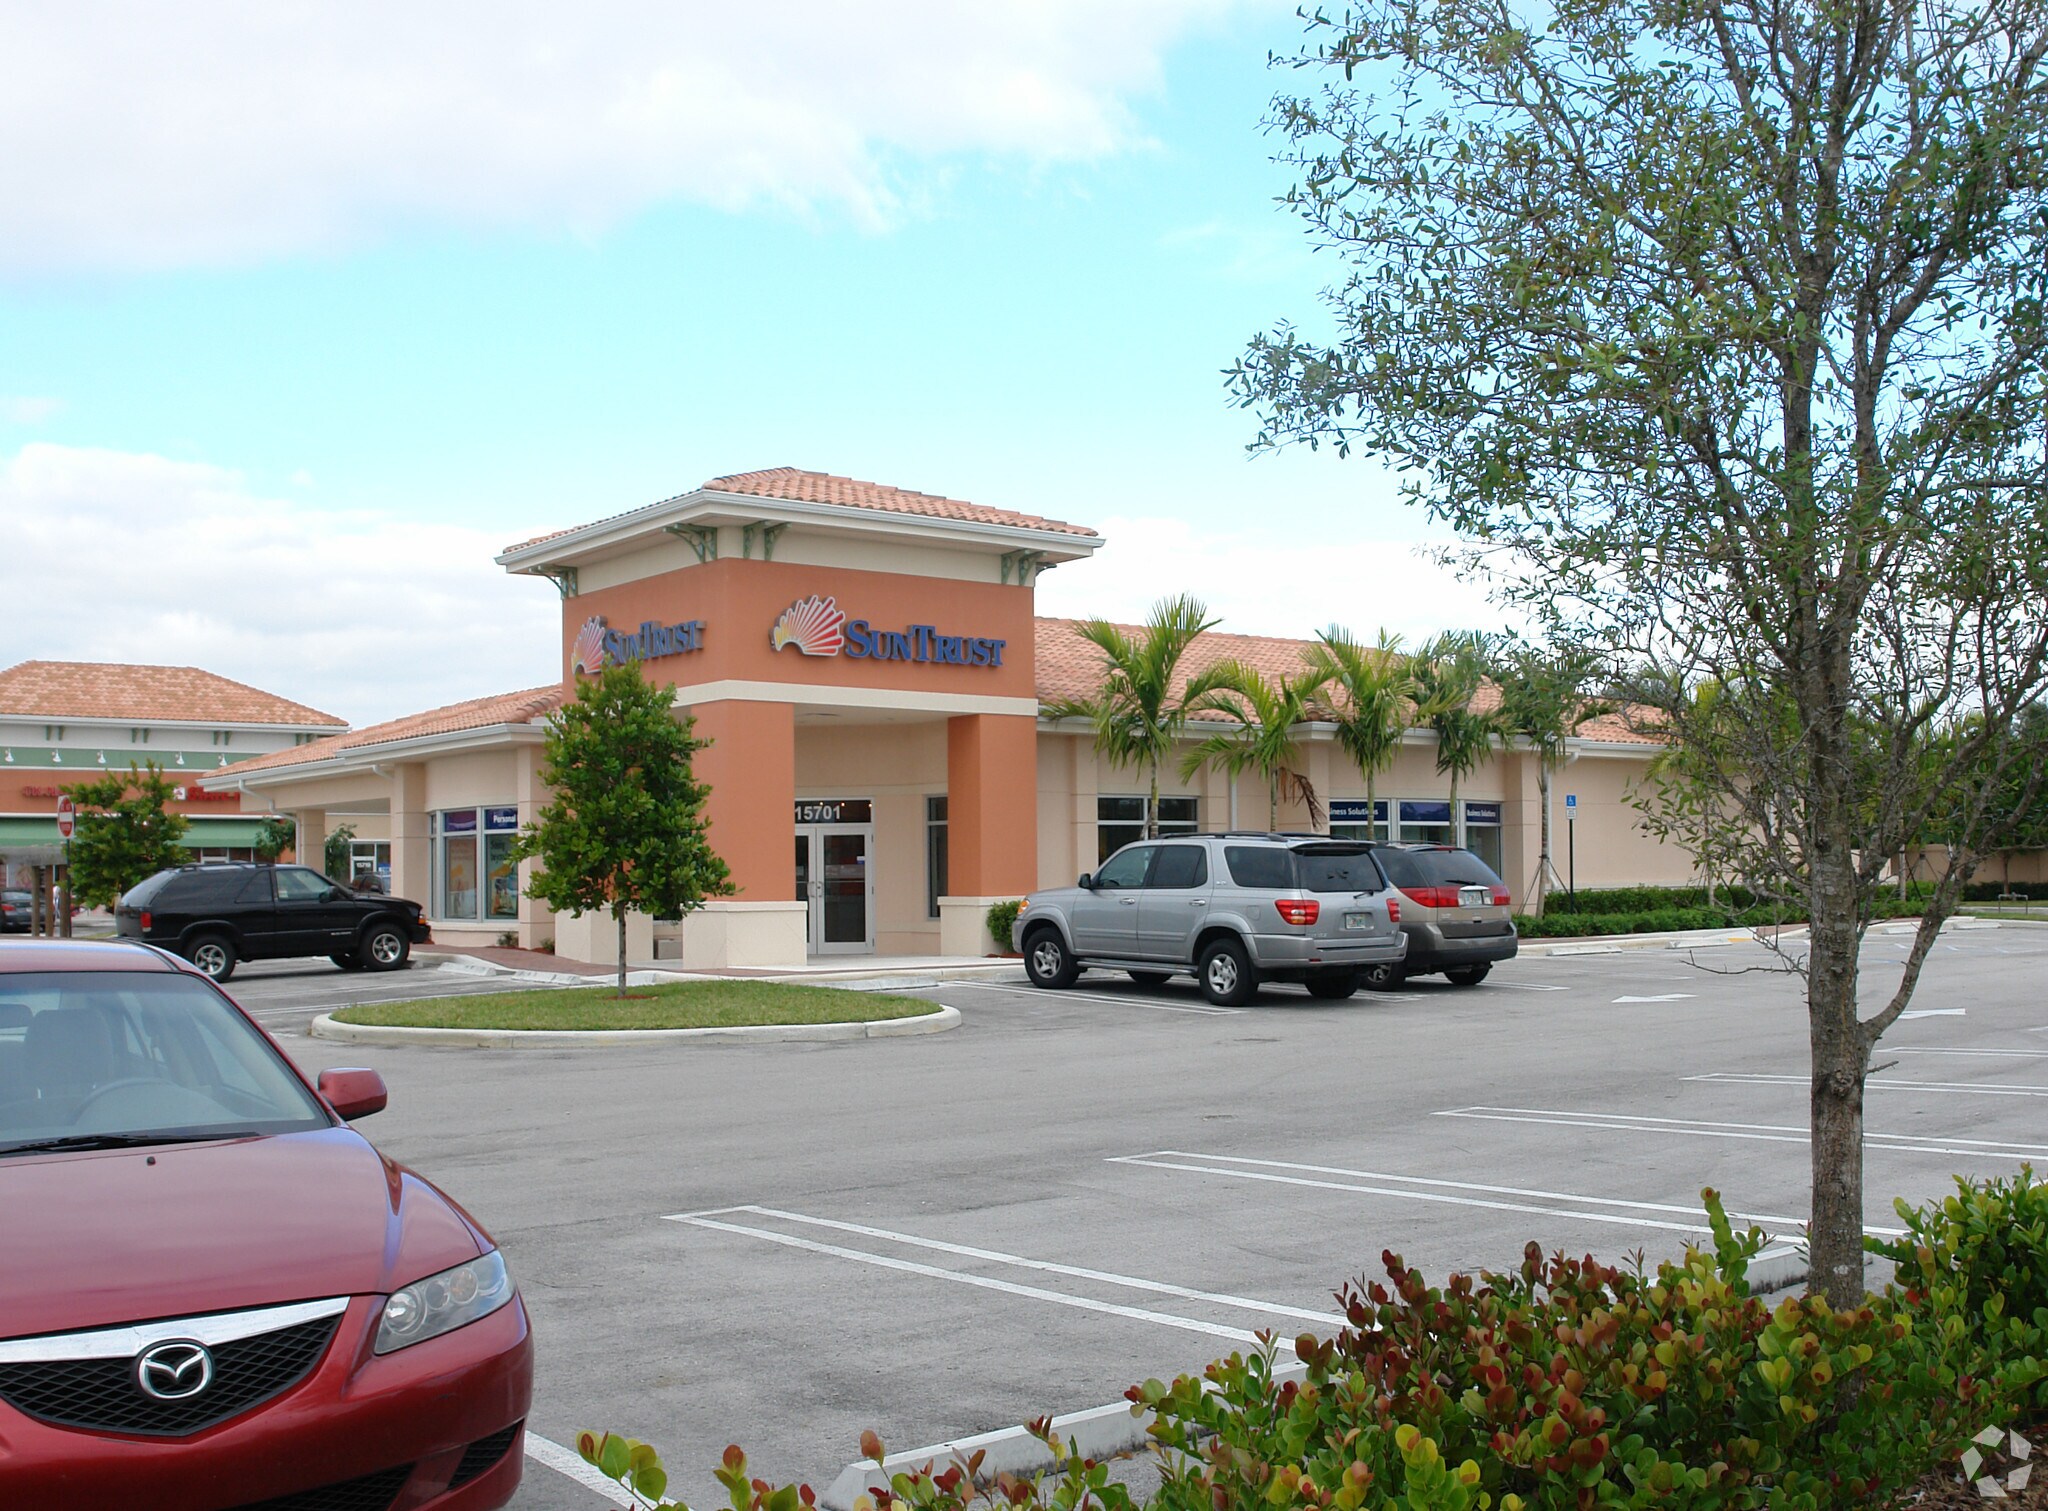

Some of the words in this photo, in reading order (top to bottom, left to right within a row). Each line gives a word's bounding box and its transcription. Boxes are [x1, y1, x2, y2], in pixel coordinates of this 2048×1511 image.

[604, 620, 702, 666] SUNTRUST
[845, 619, 1007, 667] SUNTRUST
[795, 804, 841, 820] 15701
